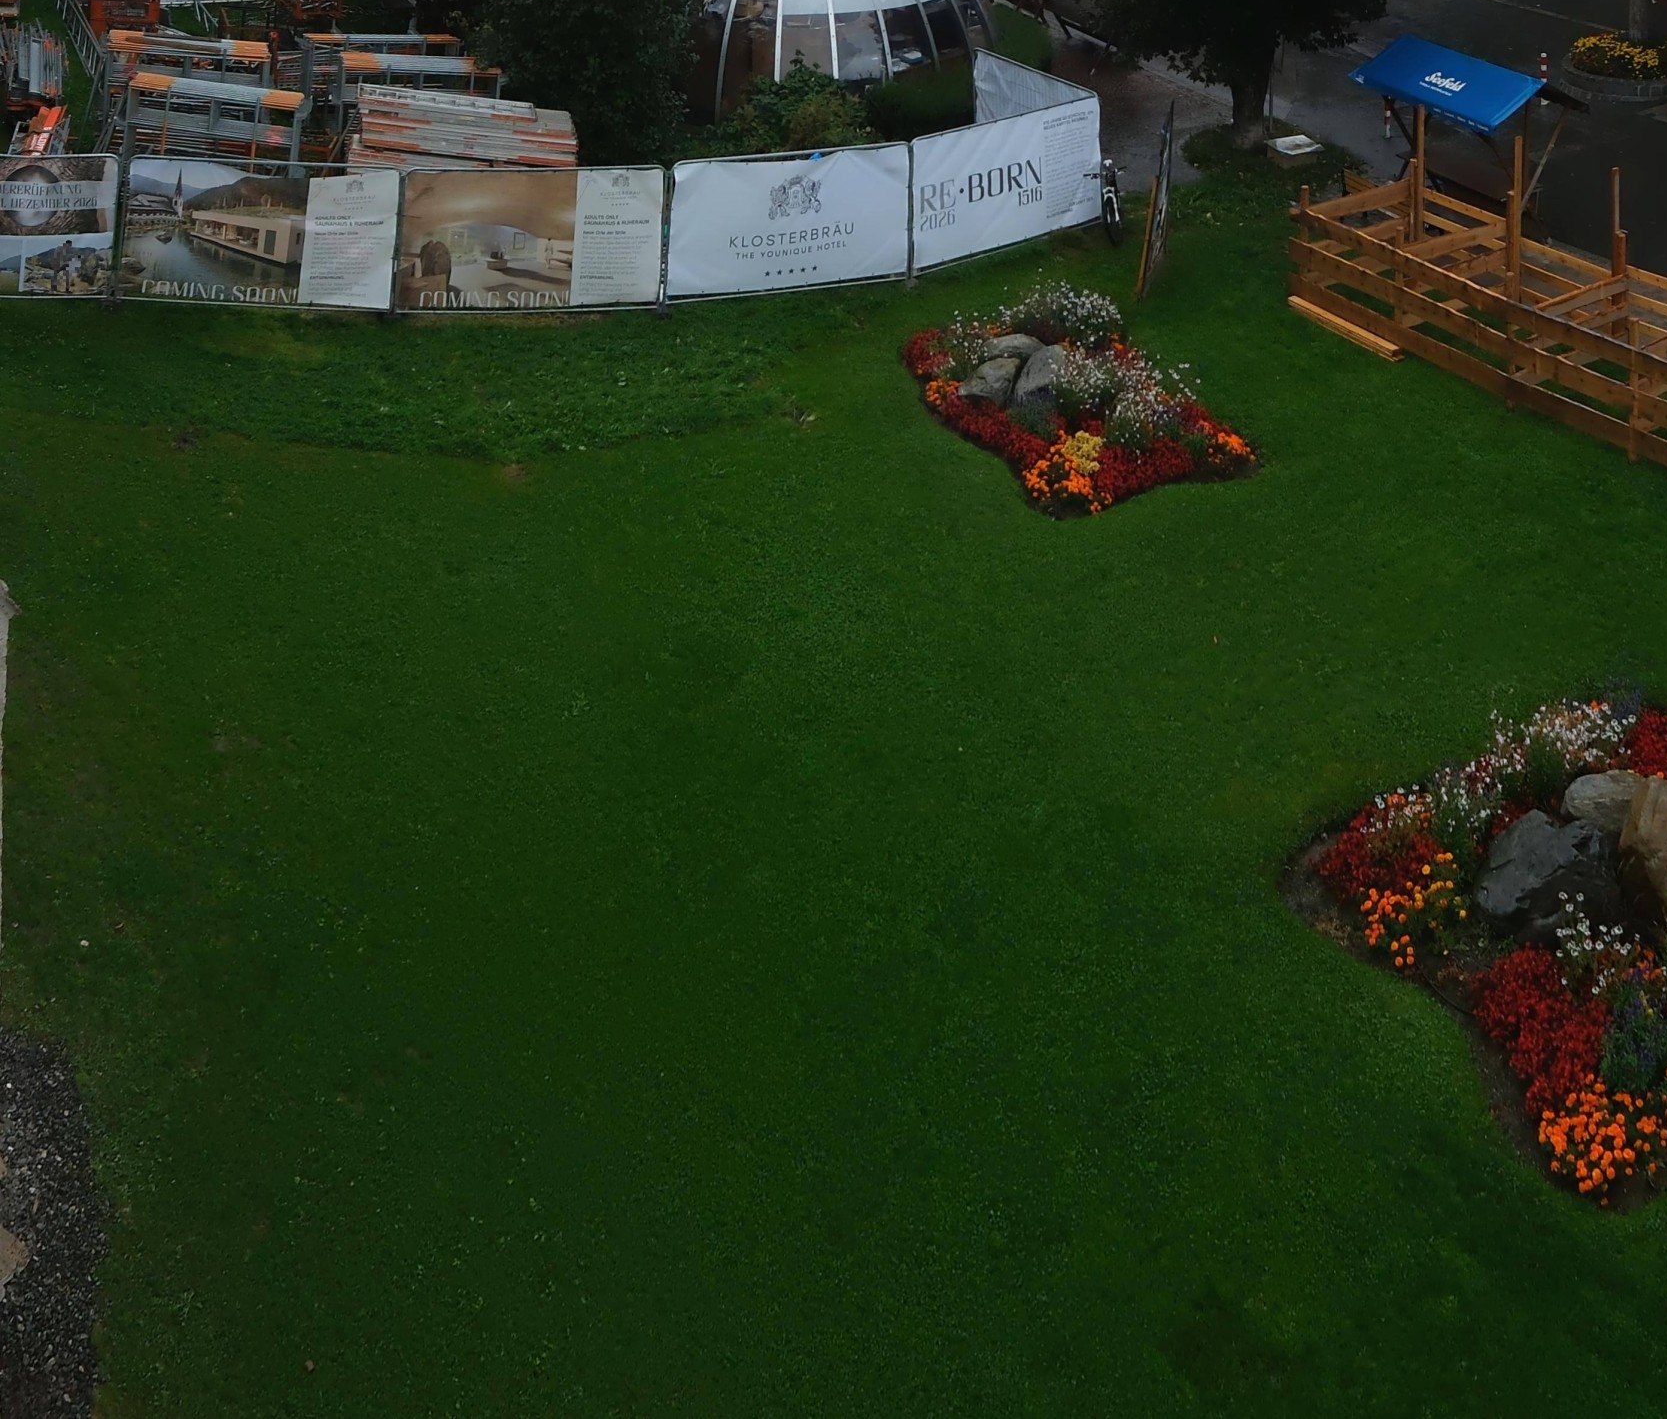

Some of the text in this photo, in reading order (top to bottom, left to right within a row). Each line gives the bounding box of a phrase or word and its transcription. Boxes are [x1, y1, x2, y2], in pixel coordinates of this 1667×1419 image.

[1424, 71, 1468, 93] Seefeld
[1018, 185, 1043, 207] 1516
[920, 211, 956, 232] 2026
[729, 222, 855, 248] KLOSTERBRÄU
[735, 241, 847, 260] THE YOUNIQUE HOTEL
[139, 280, 224, 300] COMING
[419, 291, 501, 307] COMING
